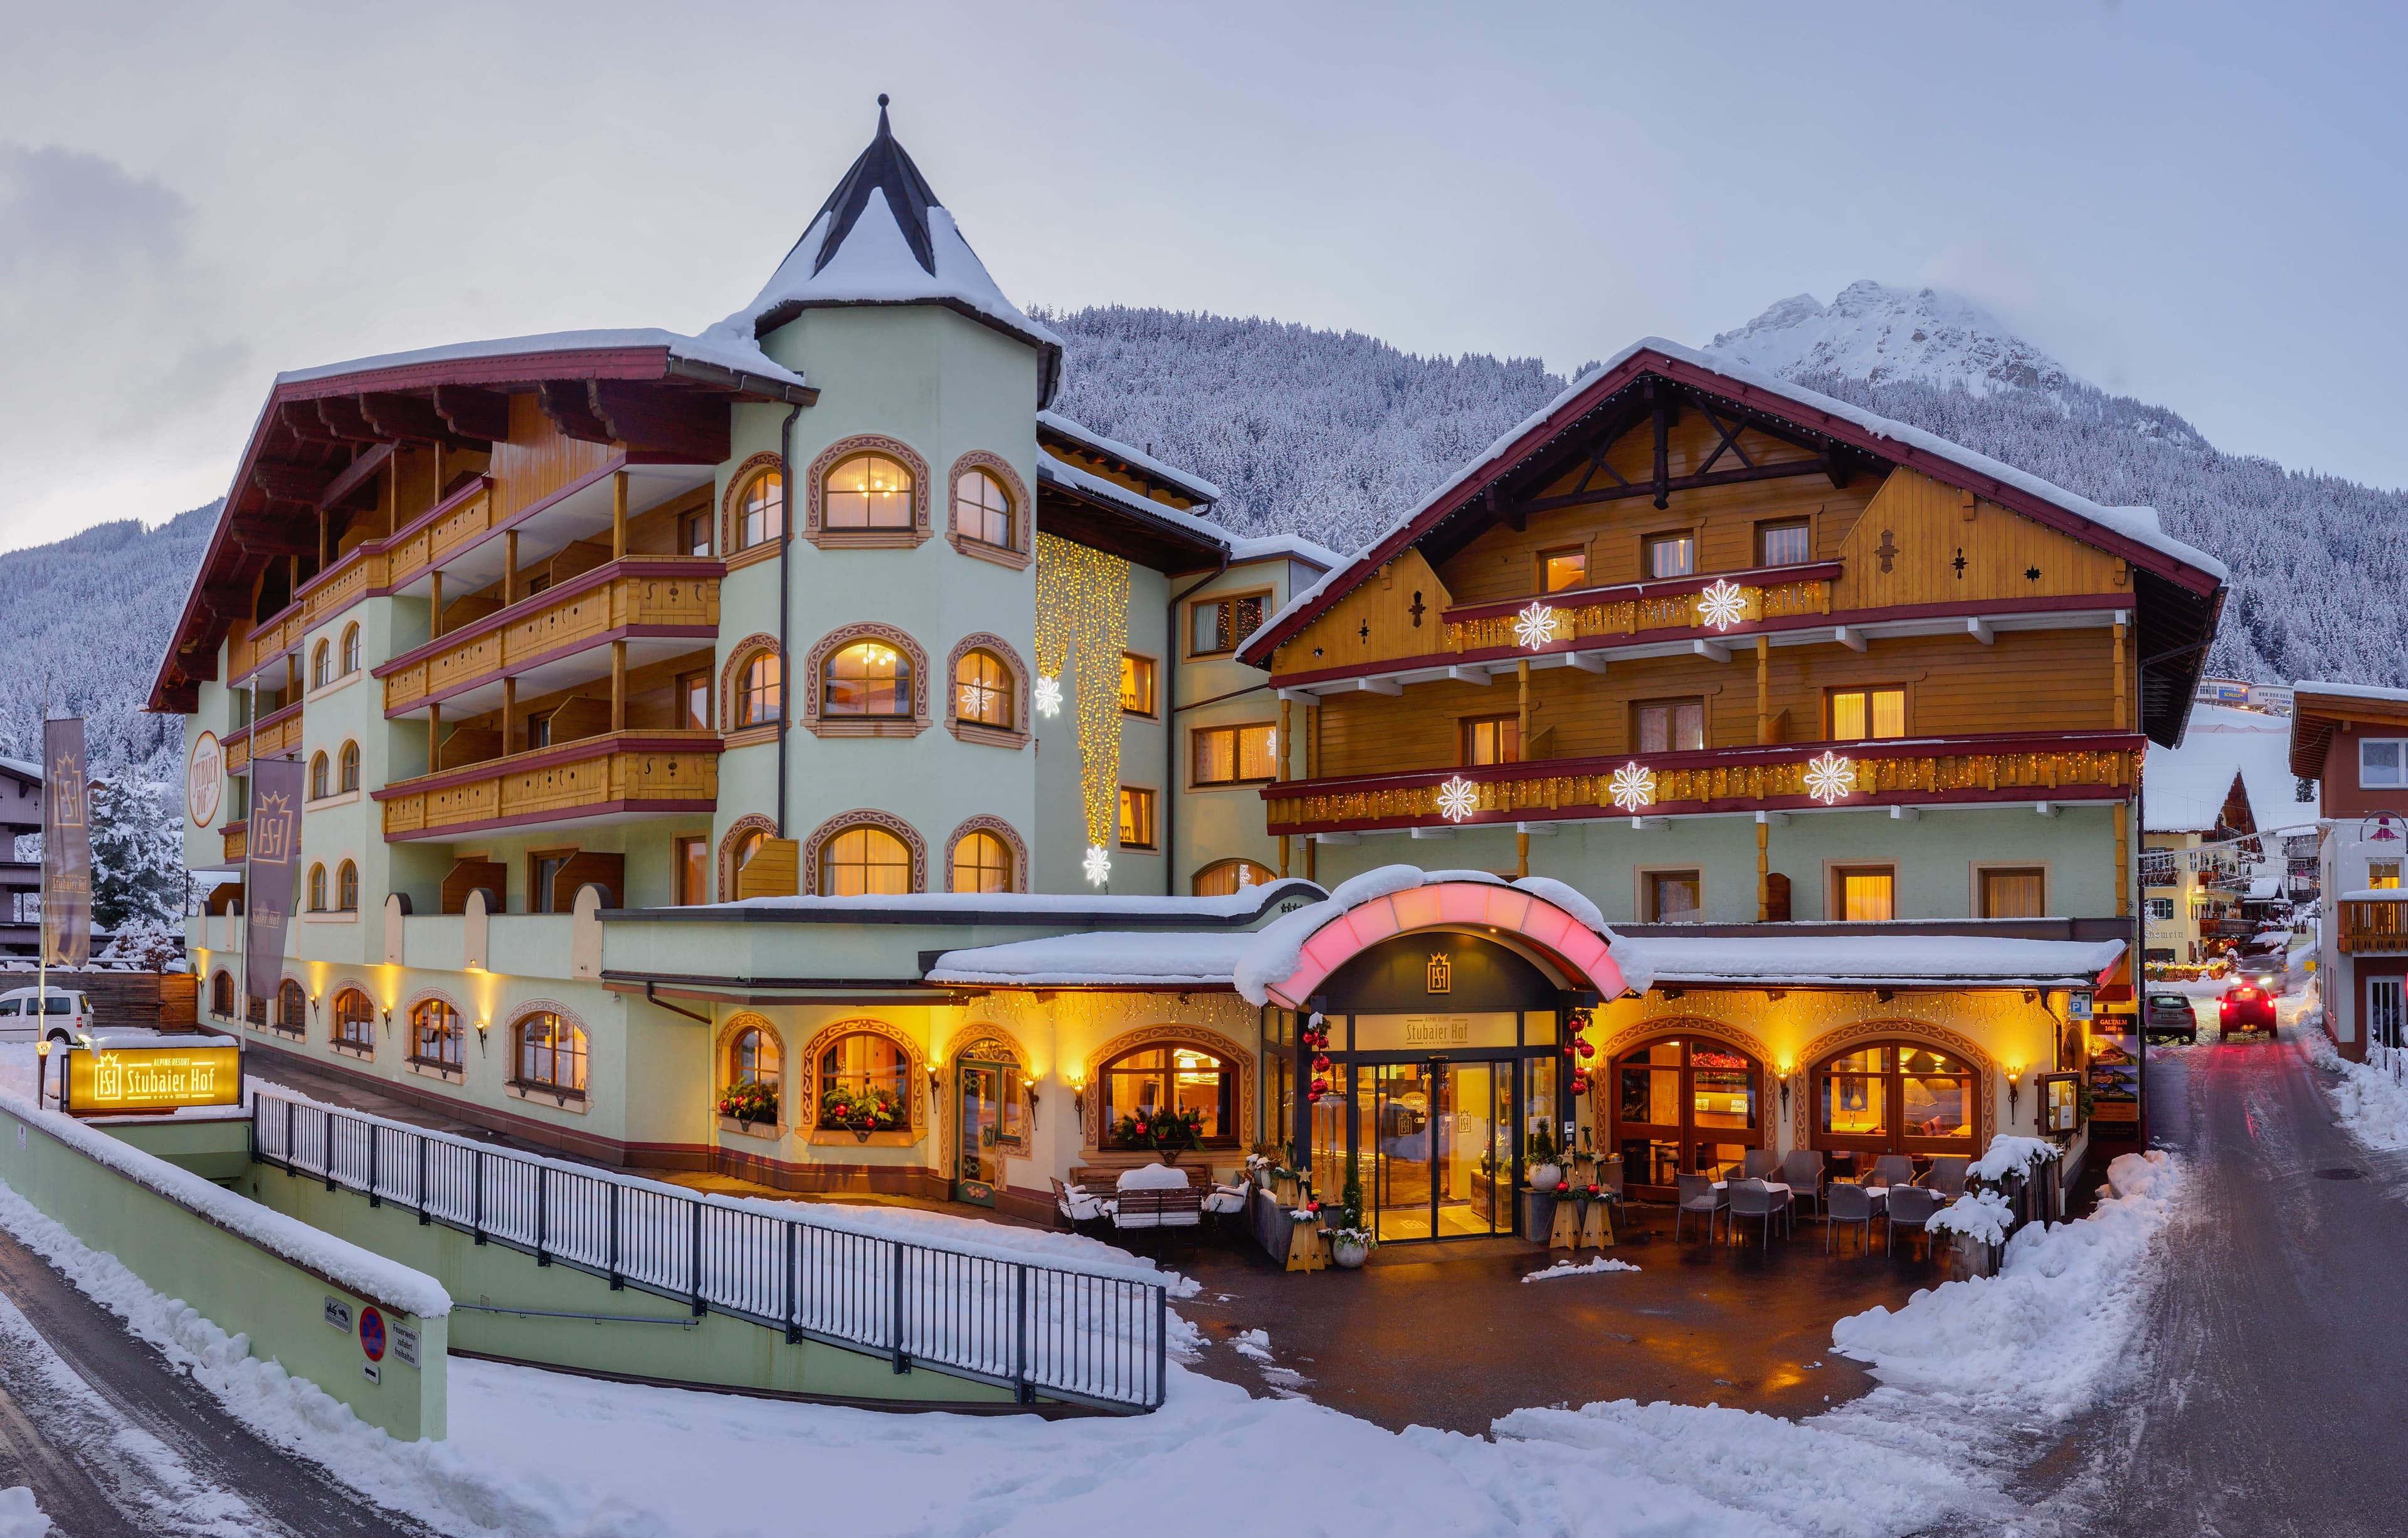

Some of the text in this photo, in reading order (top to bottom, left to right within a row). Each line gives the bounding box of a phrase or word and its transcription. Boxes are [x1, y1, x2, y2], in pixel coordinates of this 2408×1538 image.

[197, 787, 207, 815] HOF
[53, 878, 78, 890] Stubaier
[252, 912, 267, 924] baier
[2073, 1003, 2079, 1011] P
[1407, 1023, 1468, 1040] Stubaier Hof
[153, 1058, 190, 1067] ALPINE RESORT
[127, 1067, 214, 1093] Stubaier Hof
[393, 1324, 417, 1340] Feuerwehr-
[397, 1338, 413, 1352] zufahrt
[394, 1346, 415, 1364] freihalten
